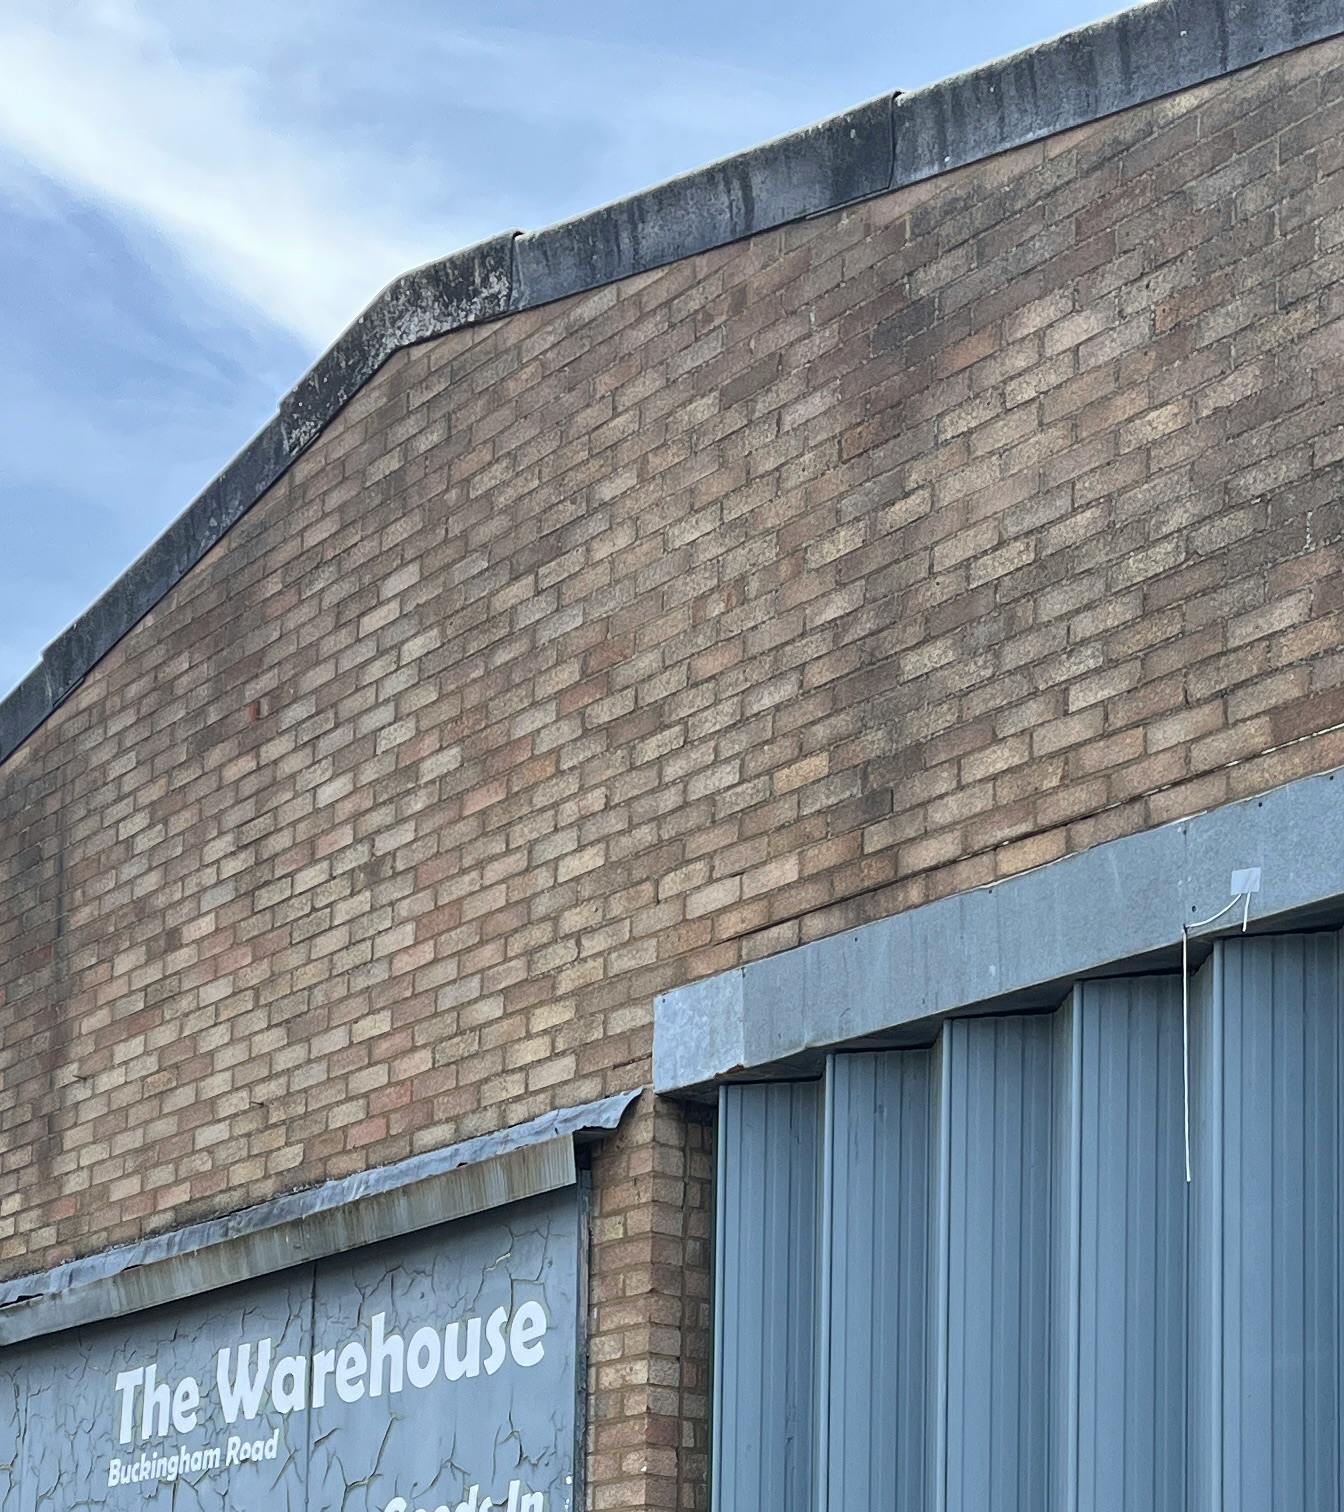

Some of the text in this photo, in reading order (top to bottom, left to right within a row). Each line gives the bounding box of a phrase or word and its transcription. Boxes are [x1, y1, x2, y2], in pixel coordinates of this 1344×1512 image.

[115, 1299, 548, 1445] The Warehouse
[107, 1428, 280, 1488] Buckingham Road
